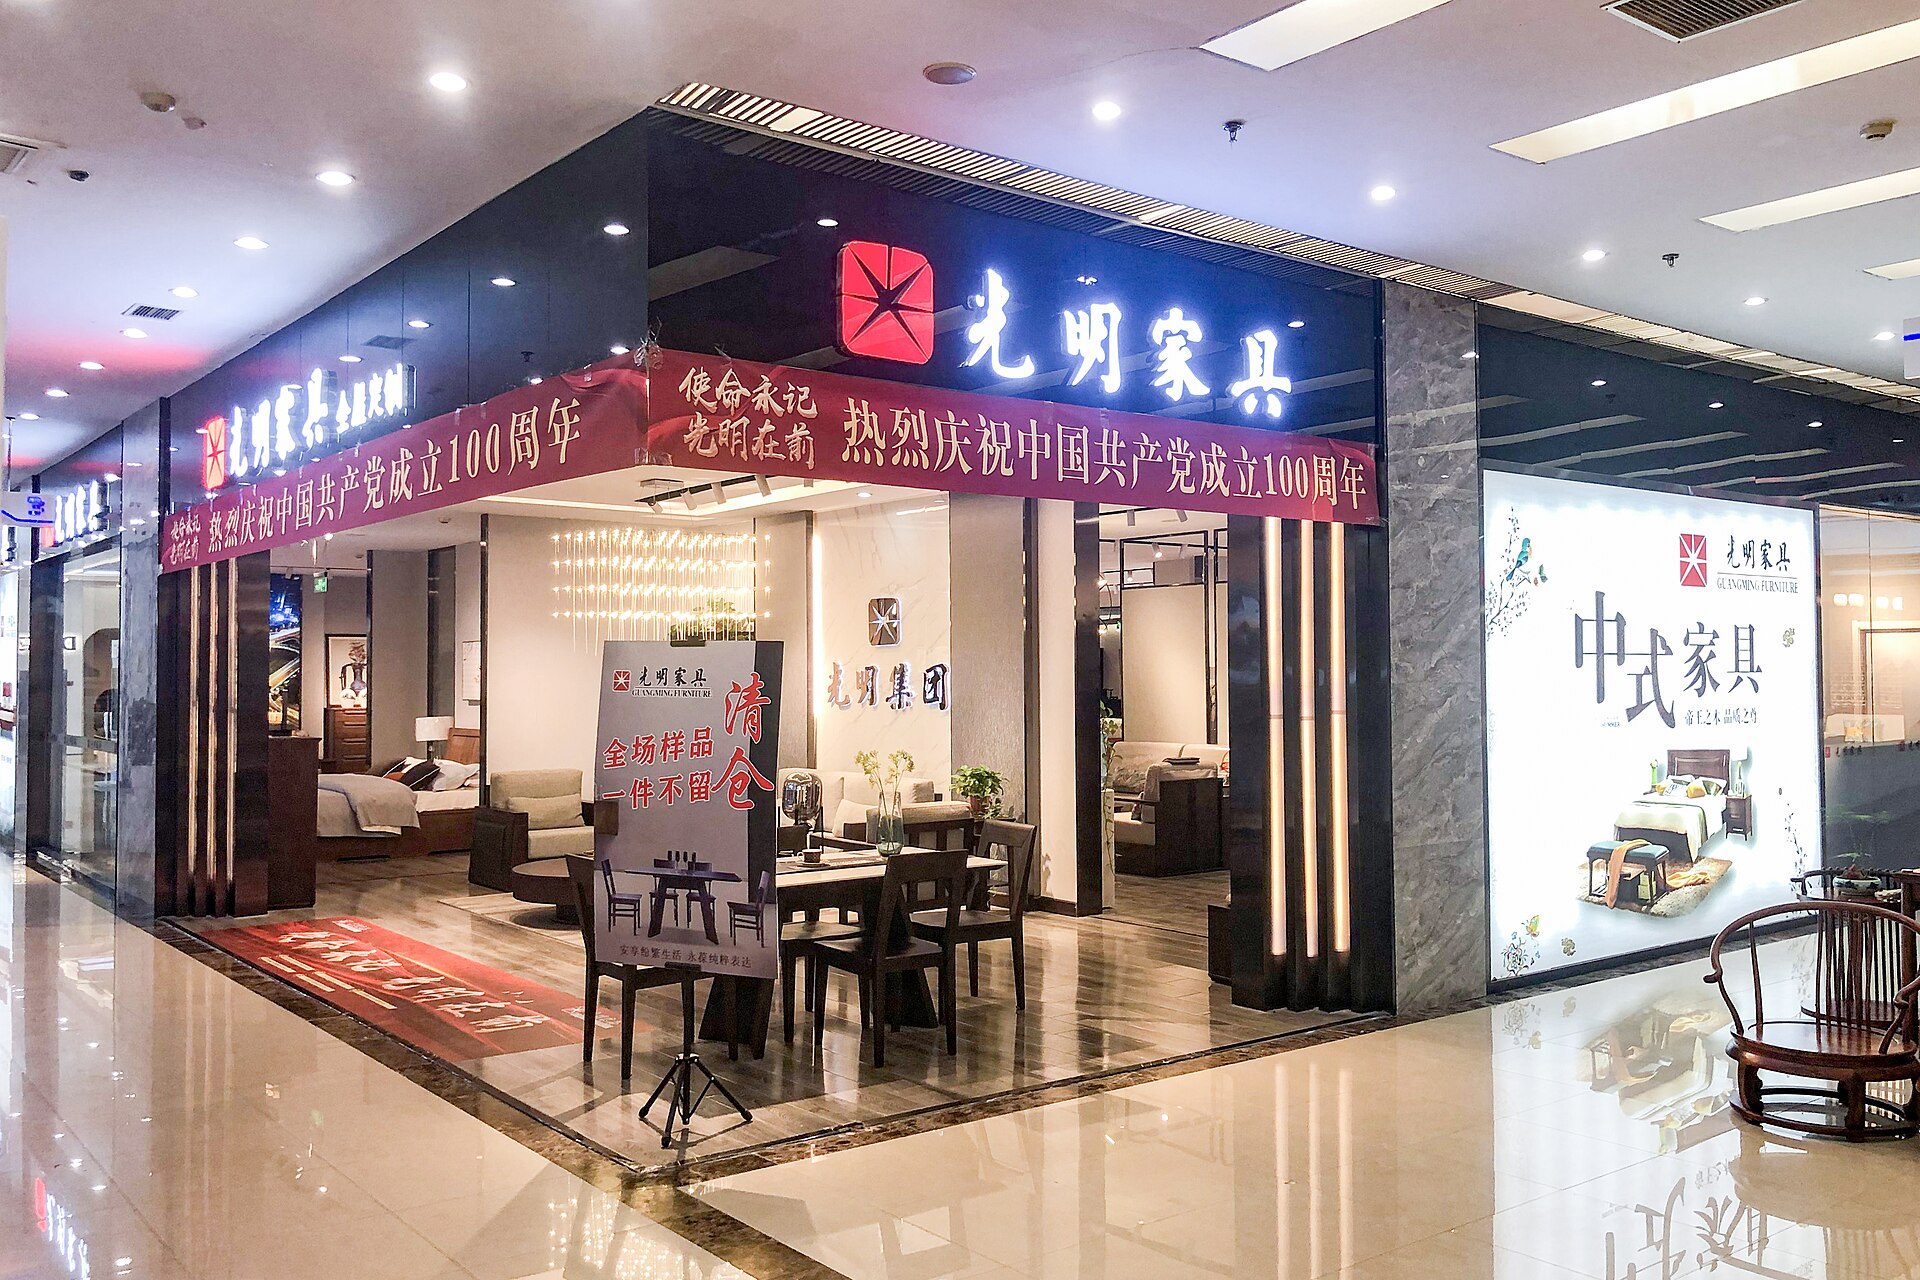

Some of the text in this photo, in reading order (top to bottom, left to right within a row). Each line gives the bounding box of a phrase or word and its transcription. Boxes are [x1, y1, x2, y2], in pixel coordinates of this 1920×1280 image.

[964, 268, 1292, 418] 光明家具
[679, 366, 818, 418] 使命永记
[230, 368, 328, 477] 光明家具
[683, 411, 816, 470] 光明在前
[208, 396, 581, 554] 热烈庆祝中国共产党成立100周年
[841, 397, 1369, 512] 热烈庆祝中国共产党成立100周年
[1727, 535, 1791, 572] 光明家具
[1717, 577, 1799, 593] GUANGMING FURNITURE
[639, 666, 707, 688] 光明家具
[1574, 591, 1763, 729] 中式家具
[631, 689, 712, 698] GUANGMING FURNITURE
[827, 662, 952, 711] 光明集团
[1723, 707, 1758, 725] 品质之尊
[602, 726, 714, 770] 全场样品
[711, 672, 775, 811] 清仓
[602, 770, 713, 810] 一件不留
